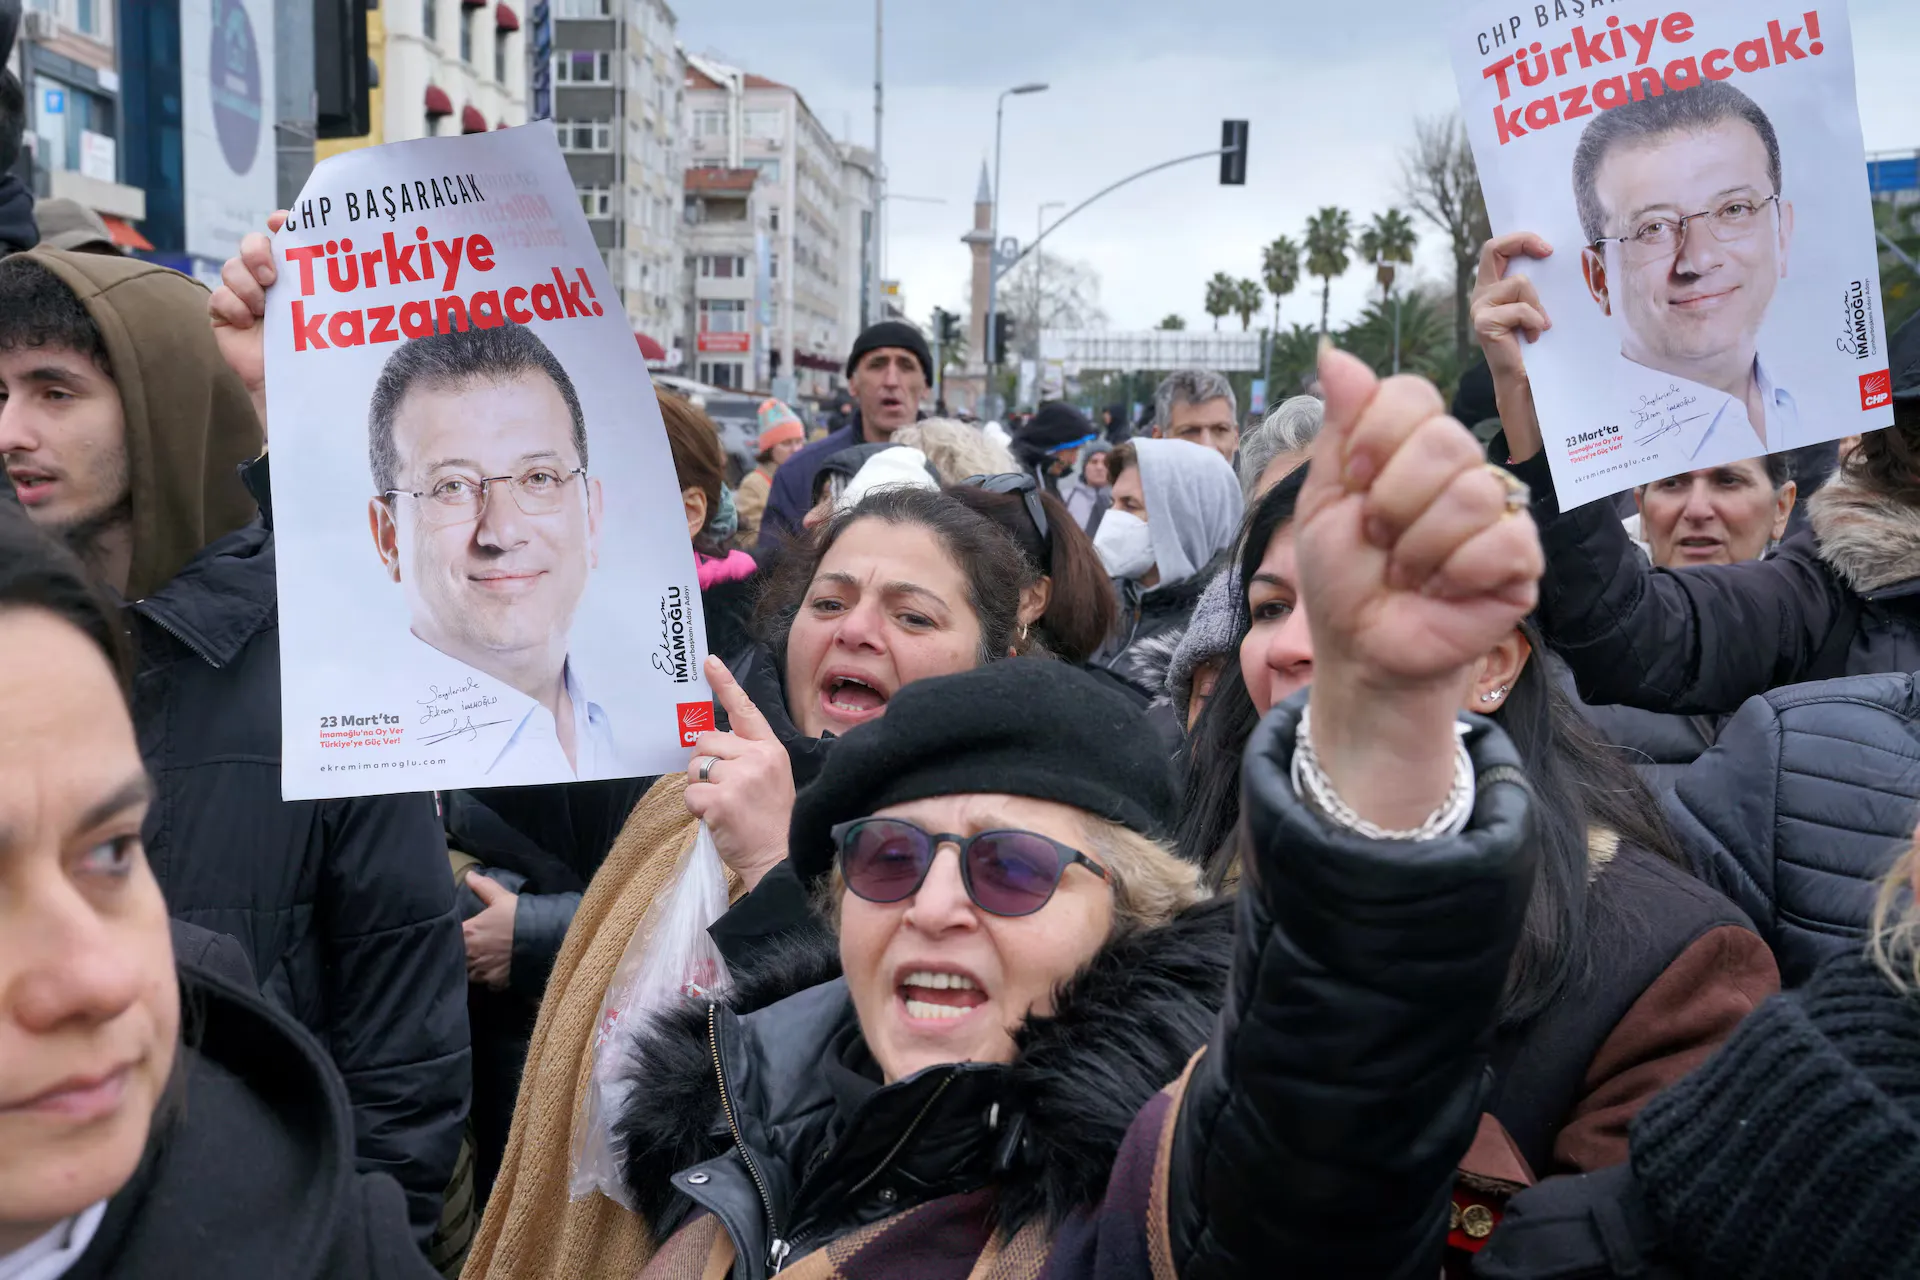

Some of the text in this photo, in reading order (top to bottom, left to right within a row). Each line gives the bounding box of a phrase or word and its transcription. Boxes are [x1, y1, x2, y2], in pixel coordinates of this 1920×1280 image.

[1477, 15, 1522, 56] CHP
[1483, 11, 1694, 101] Türkiye
[1493, 11, 1824, 146] kazanacak!
[345, 173, 486, 222] BAŞARACAK
[285, 225, 496, 296] Türkiye
[291, 266, 604, 352] kazanacak!
[1850, 280, 1869, 360] İMAMOĞLU
[1865, 392, 1888, 406] CHP
[1565, 436, 1578, 448] 23
[1578, 425, 1619, 443] Mart'ta
[1609, 443, 1622, 451] Ver!
[1574, 453, 1660, 484] ekremimamoglu.com
[652, 596, 676, 676] Ekrem
[668, 586, 689, 684] İMAMOĞLU
[688, 627, 698, 681] Cumhurbaşkanı
[320, 713, 400, 728] 23 Mart'ta
[320, 729, 374, 738] İmamoğlu'na
[375, 728, 388, 736] Oy
[684, 731, 706, 742] CH
[320, 737, 401, 749] Türkiye'ye Güç Ver!
[320, 757, 447, 773] ekremimamoglu.com
